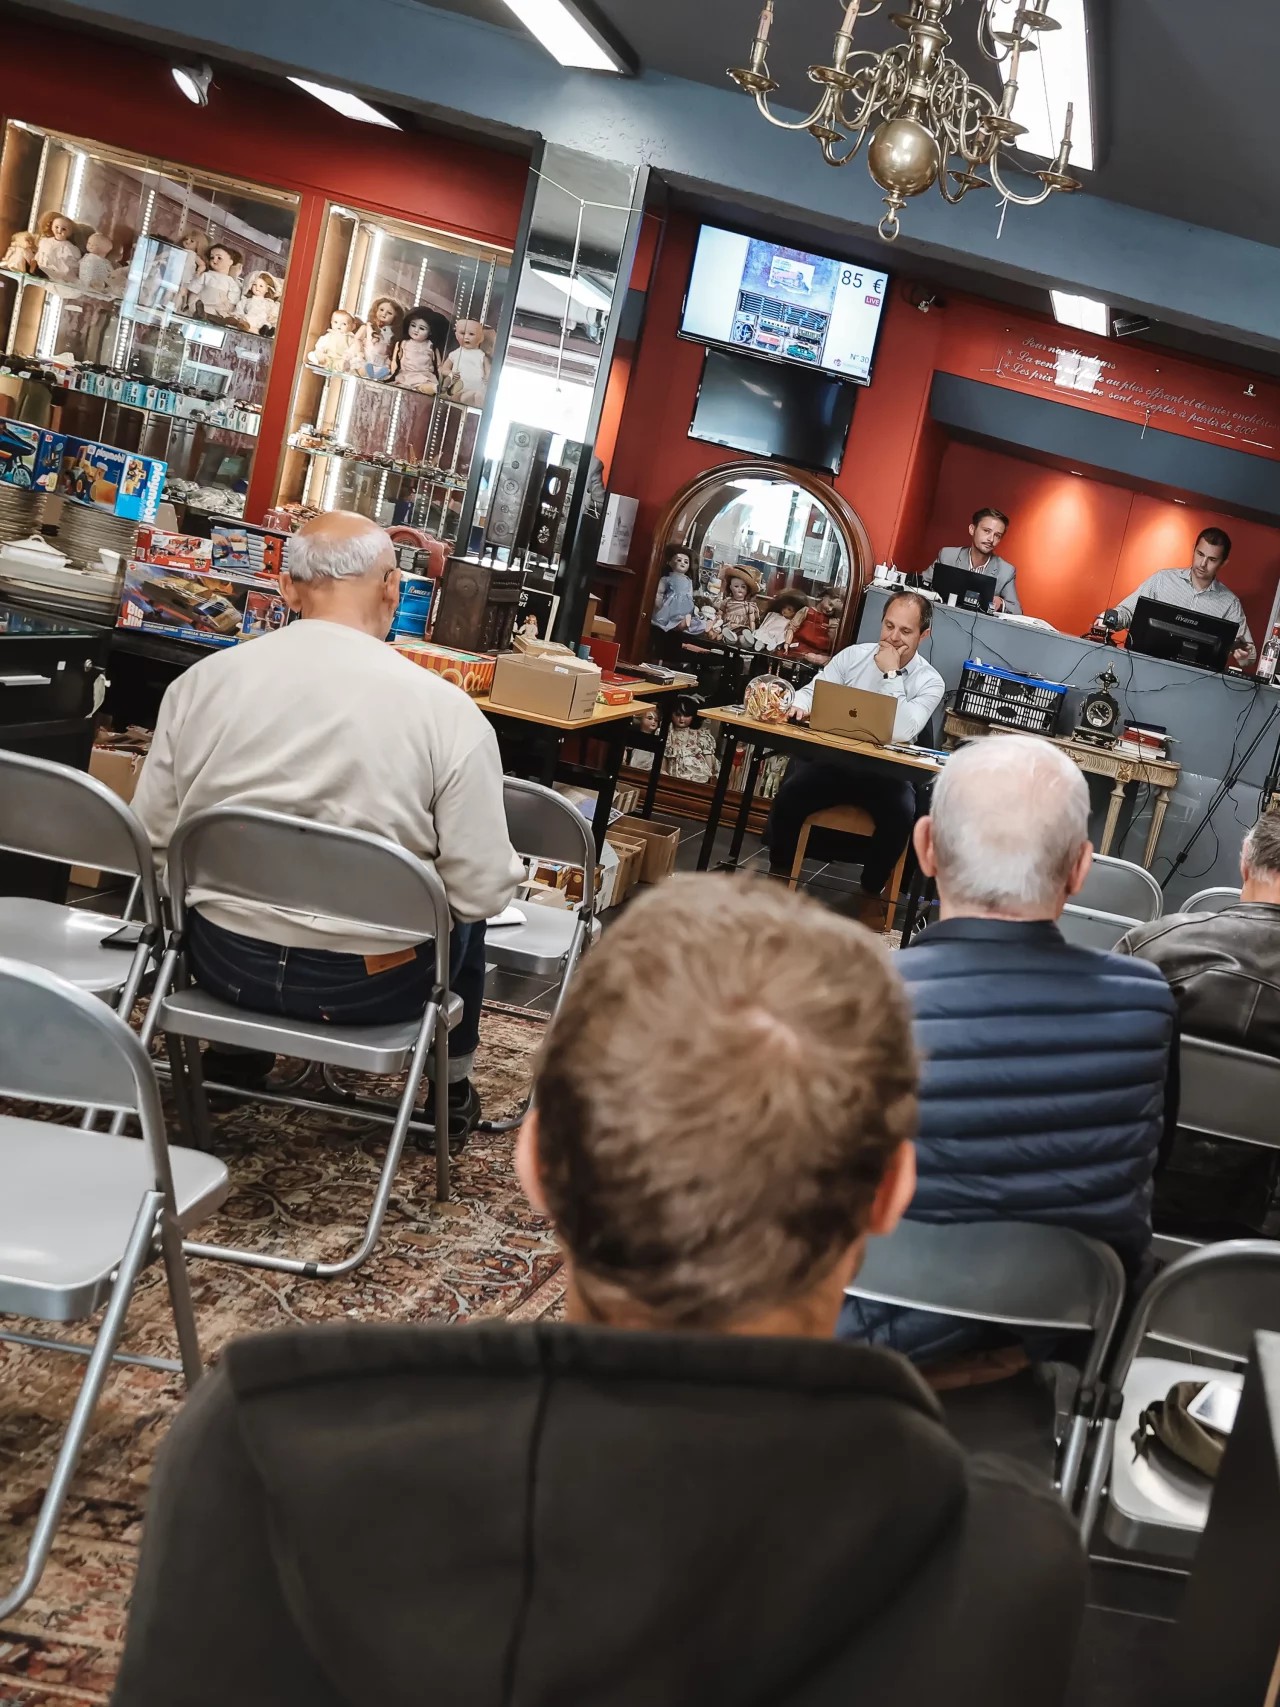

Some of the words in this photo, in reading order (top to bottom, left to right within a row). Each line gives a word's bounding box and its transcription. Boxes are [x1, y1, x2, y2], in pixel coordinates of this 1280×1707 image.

[841, 270, 863, 288] 85
[873, 278, 884, 294] €
[865, 296, 880, 306] LIVE
[1048, 346, 1066, 356] nos
[1035, 358, 1063, 371] vente
[1106, 378, 1120, 387] au
[1119, 380, 1143, 394] plus
[1146, 387, 1182, 405] offrant
[1195, 400, 1229, 417] dernier
[1029, 369, 1053, 383] prix
[1108, 391, 1131, 403] sont
[1134, 398, 1176, 417] acceptés
[1187, 412, 1219, 428] partir
[1221, 419, 1233, 431] de
[95, 447, 126, 463] playmobil
[143, 461, 164, 524] playmobil
[127, 600, 144, 619] BIG
[123, 614, 143, 628] JIM
[1175, 614, 1199, 626] iiyama
